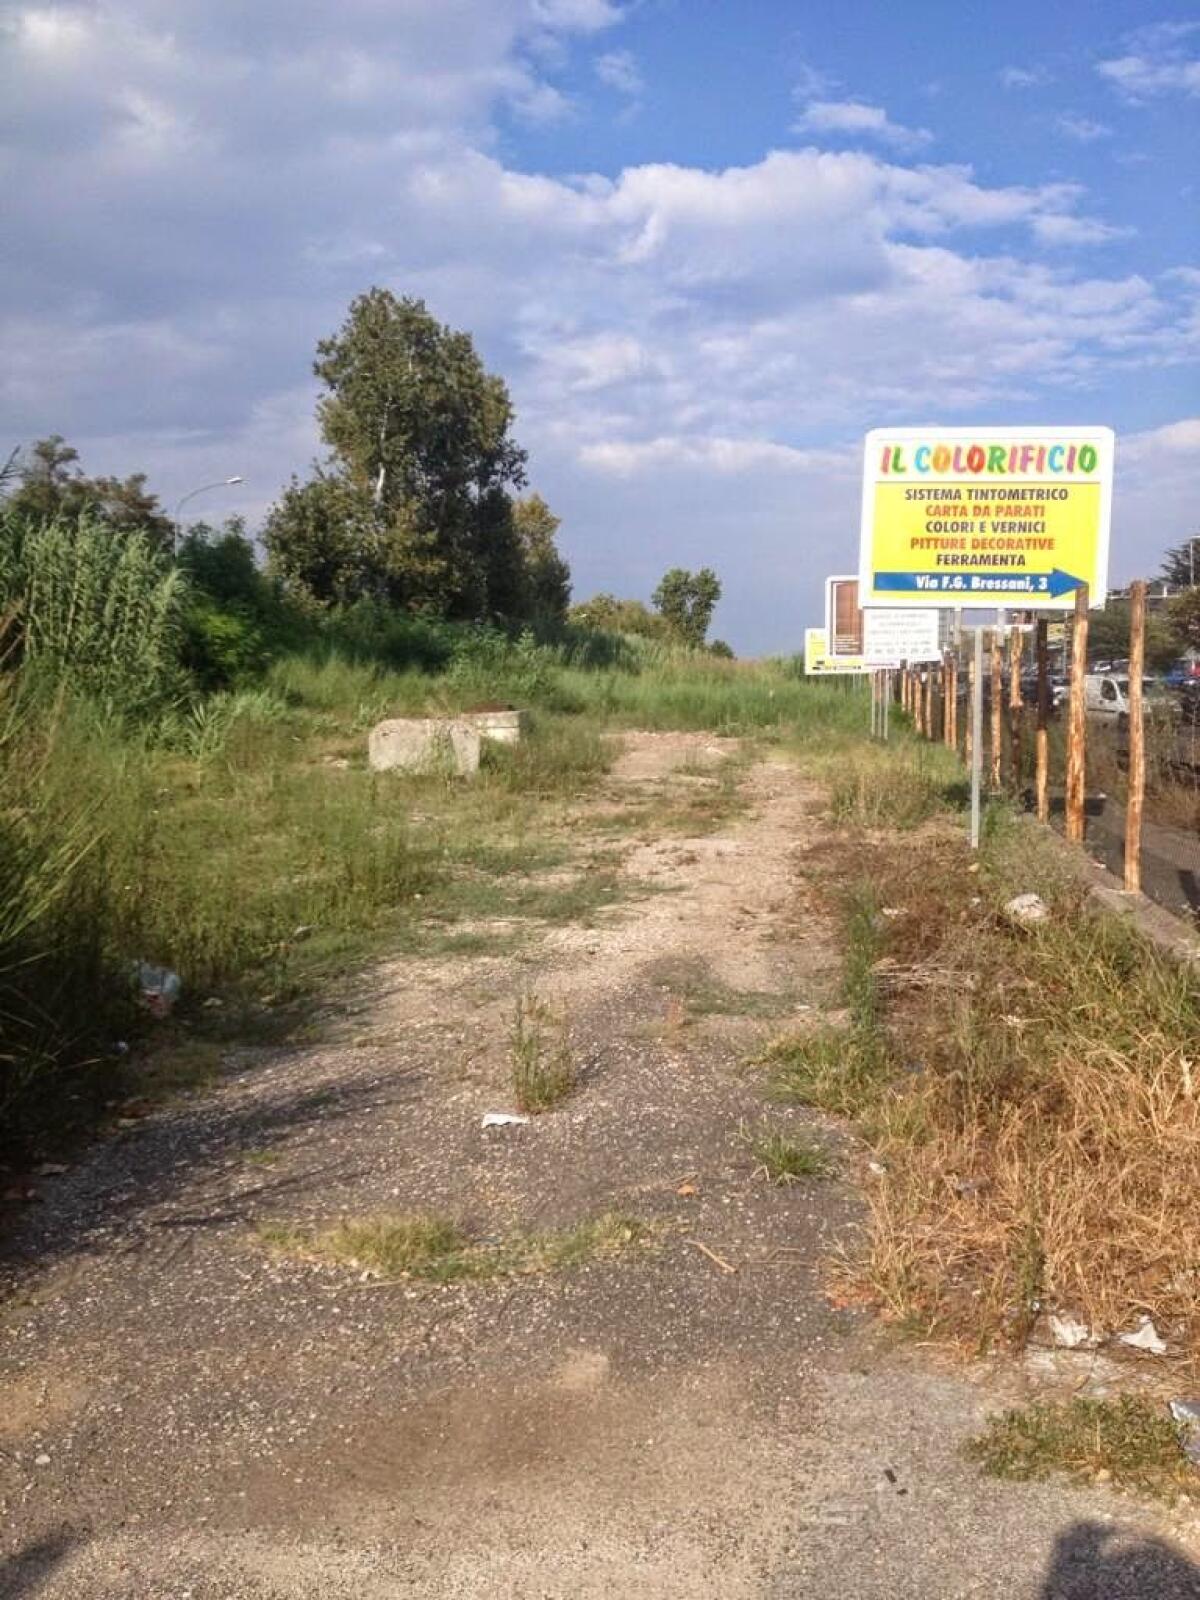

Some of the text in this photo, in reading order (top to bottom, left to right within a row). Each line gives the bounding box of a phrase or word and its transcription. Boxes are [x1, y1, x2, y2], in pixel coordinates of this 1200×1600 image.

[881, 444, 1098, 474] IL COLORIFICIO
[905, 488, 1069, 501] SISTEMA TINTOMETRICO
[926, 504, 1046, 518] CARTA DA PARATI
[926, 521, 1046, 534] COLORI E VERNICI
[911, 537, 1056, 551] PITTURE DECORATIVE
[936, 553, 1026, 567] FERRAMENTA
[916, 575, 1049, 593] Via F.G. Bressani, 3
